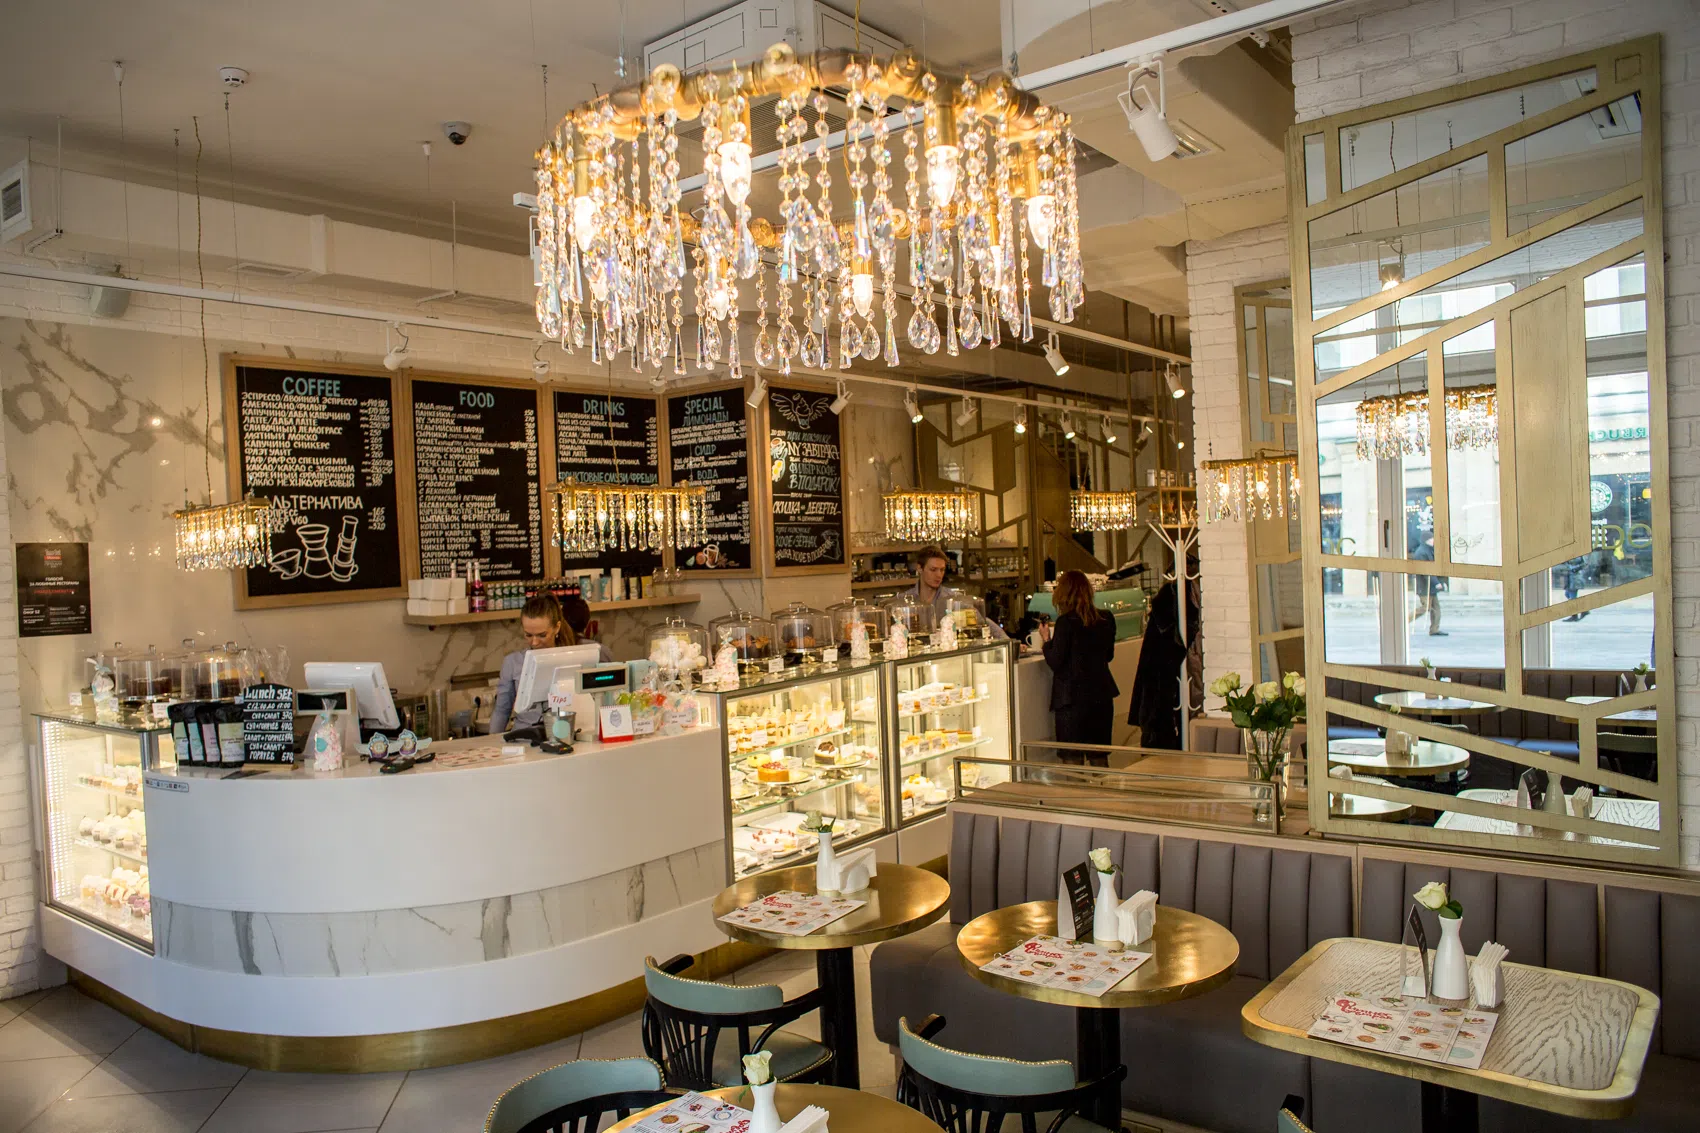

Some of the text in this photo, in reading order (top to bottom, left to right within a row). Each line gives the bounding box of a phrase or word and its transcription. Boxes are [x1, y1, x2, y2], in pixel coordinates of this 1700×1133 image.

[282, 377, 340, 397] COFFEE
[322, 397, 358, 406] ЭСПРЕССО
[460, 391, 495, 407] FOOD
[415, 402, 434, 411] КАША
[583, 399, 625, 416] DRINKS
[685, 396, 724, 415] SPECIAL
[309, 412, 351, 420] КАПУЧИНО
[415, 410, 451, 418] ПАНКЕЙКИ
[682, 411, 729, 426] ЛИМОНАДЫ
[296, 418, 318, 426] ЛАТТЕ
[244, 424, 343, 435] СЛИВОЧНЫЙ ЛЕМОГРАСС
[416, 424, 484, 434] БЕЛЬГИЙСКИЕ ВАФЛИ
[244, 432, 285, 440] МЯТНЫЙ
[416, 431, 448, 439] СЫРНИКИ
[244, 440, 290, 448] КАПУЧИНО
[244, 448, 268, 456] ФЛЭТ
[417, 445, 464, 453] БРУКЛИНСКИЙ
[465, 447, 494, 455] СКРЕМБЛ
[695, 444, 716, 456] СИДР
[787, 442, 840, 460] NY ЗАВТРАКА
[298, 457, 347, 465] СПЕЦИЯМИ
[457, 460, 480, 468] САЛАТ
[464, 468, 500, 476] ИНДЕЙКОЙ
[789, 463, 837, 475] ФИЛЬТР КОФЕ
[418, 474, 438, 482] ЯЙЦА
[697, 469, 718, 480] ВОДА
[788, 474, 840, 495] В ПОДАРОК!
[773, 501, 800, 514] СКИДКА
[805, 502, 841, 515] ДЕСЕРТЫ
[462, 510, 510, 521] ФЕРМЕРСКИЙ
[776, 536, 793, 548] КОФЕ
[245, 685, 275, 699] Lunch
[552, 695, 566, 704] Tips
